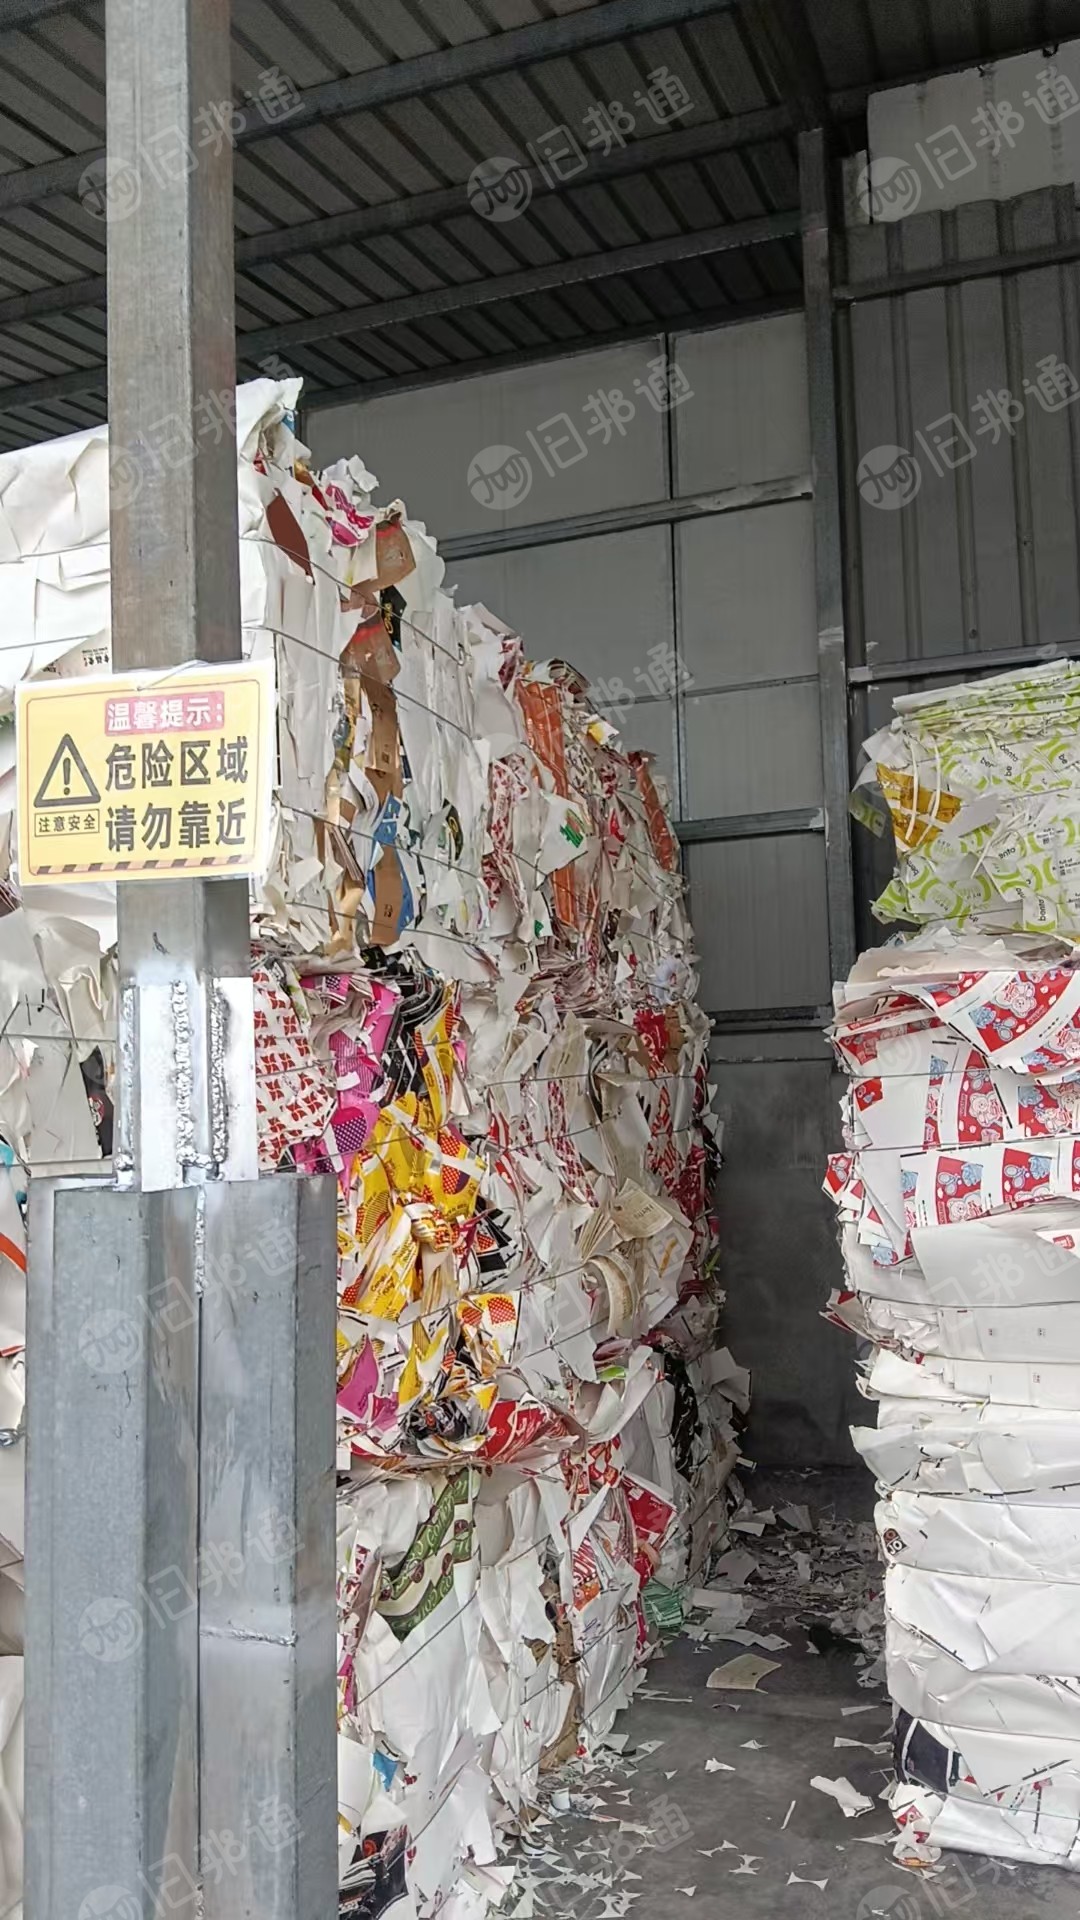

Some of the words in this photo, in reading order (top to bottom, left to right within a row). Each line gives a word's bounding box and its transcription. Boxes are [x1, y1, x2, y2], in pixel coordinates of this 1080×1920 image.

[105, 736, 248, 792] 危险区域
[38, 813, 96, 834] 注意安全
[105, 798, 246, 852] 请勿靠近
